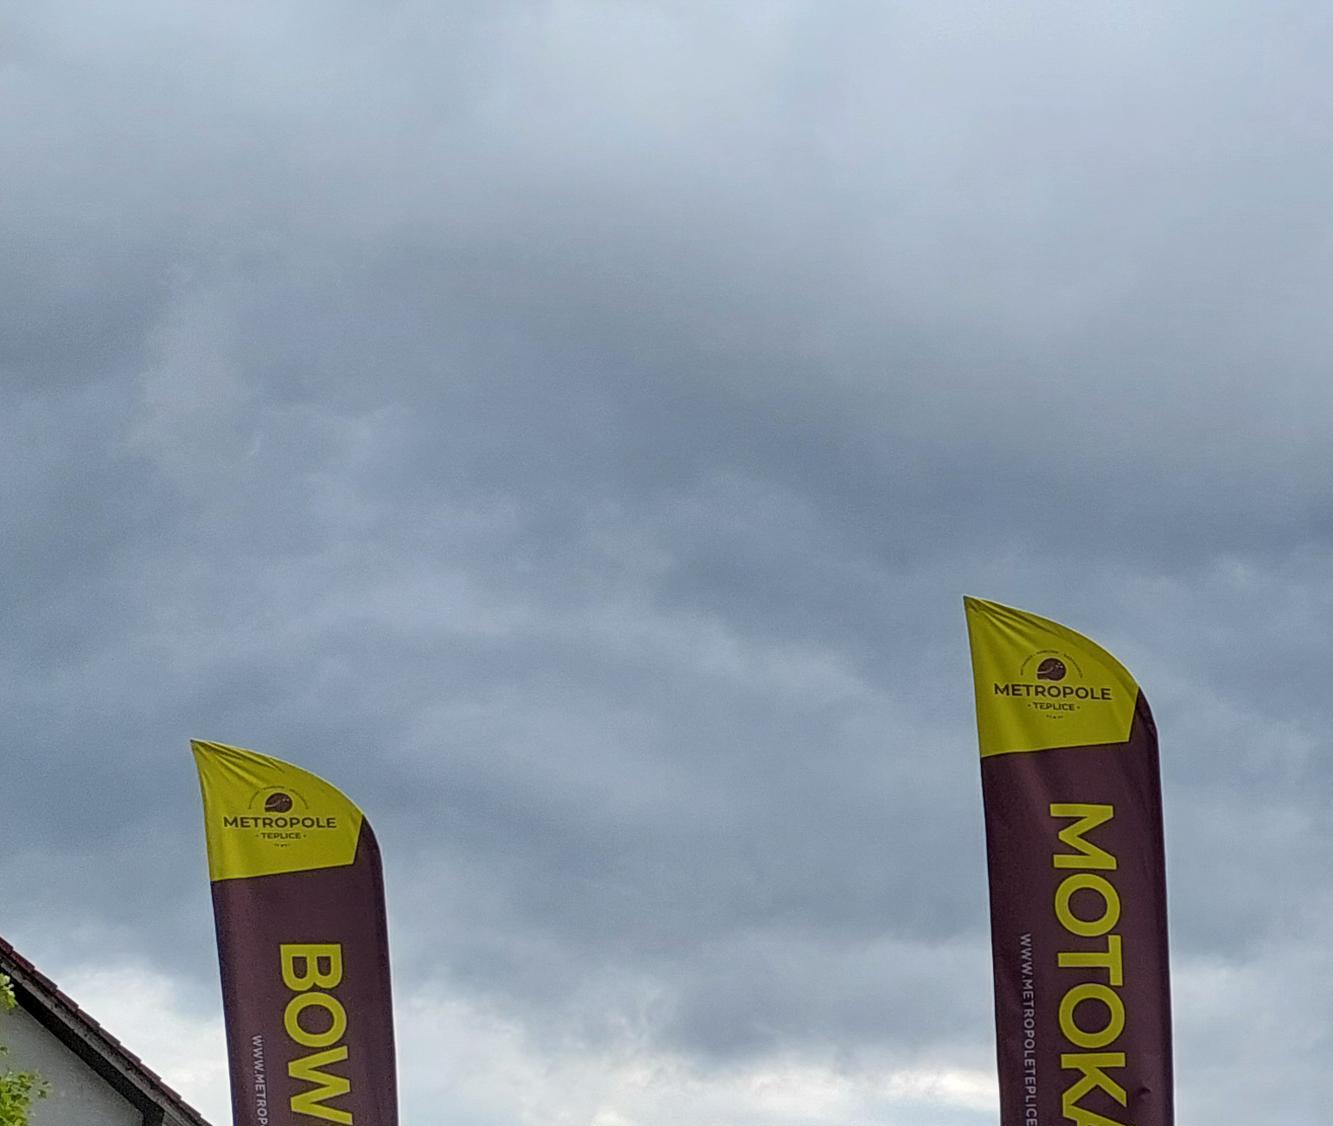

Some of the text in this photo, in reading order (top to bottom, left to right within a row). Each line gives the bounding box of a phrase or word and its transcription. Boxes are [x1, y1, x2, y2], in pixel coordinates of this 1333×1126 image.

[993, 682, 1112, 700] METROPOLE
[1033, 702, 1075, 711] TEPLICE
[223, 816, 337, 828] METROPOLE
